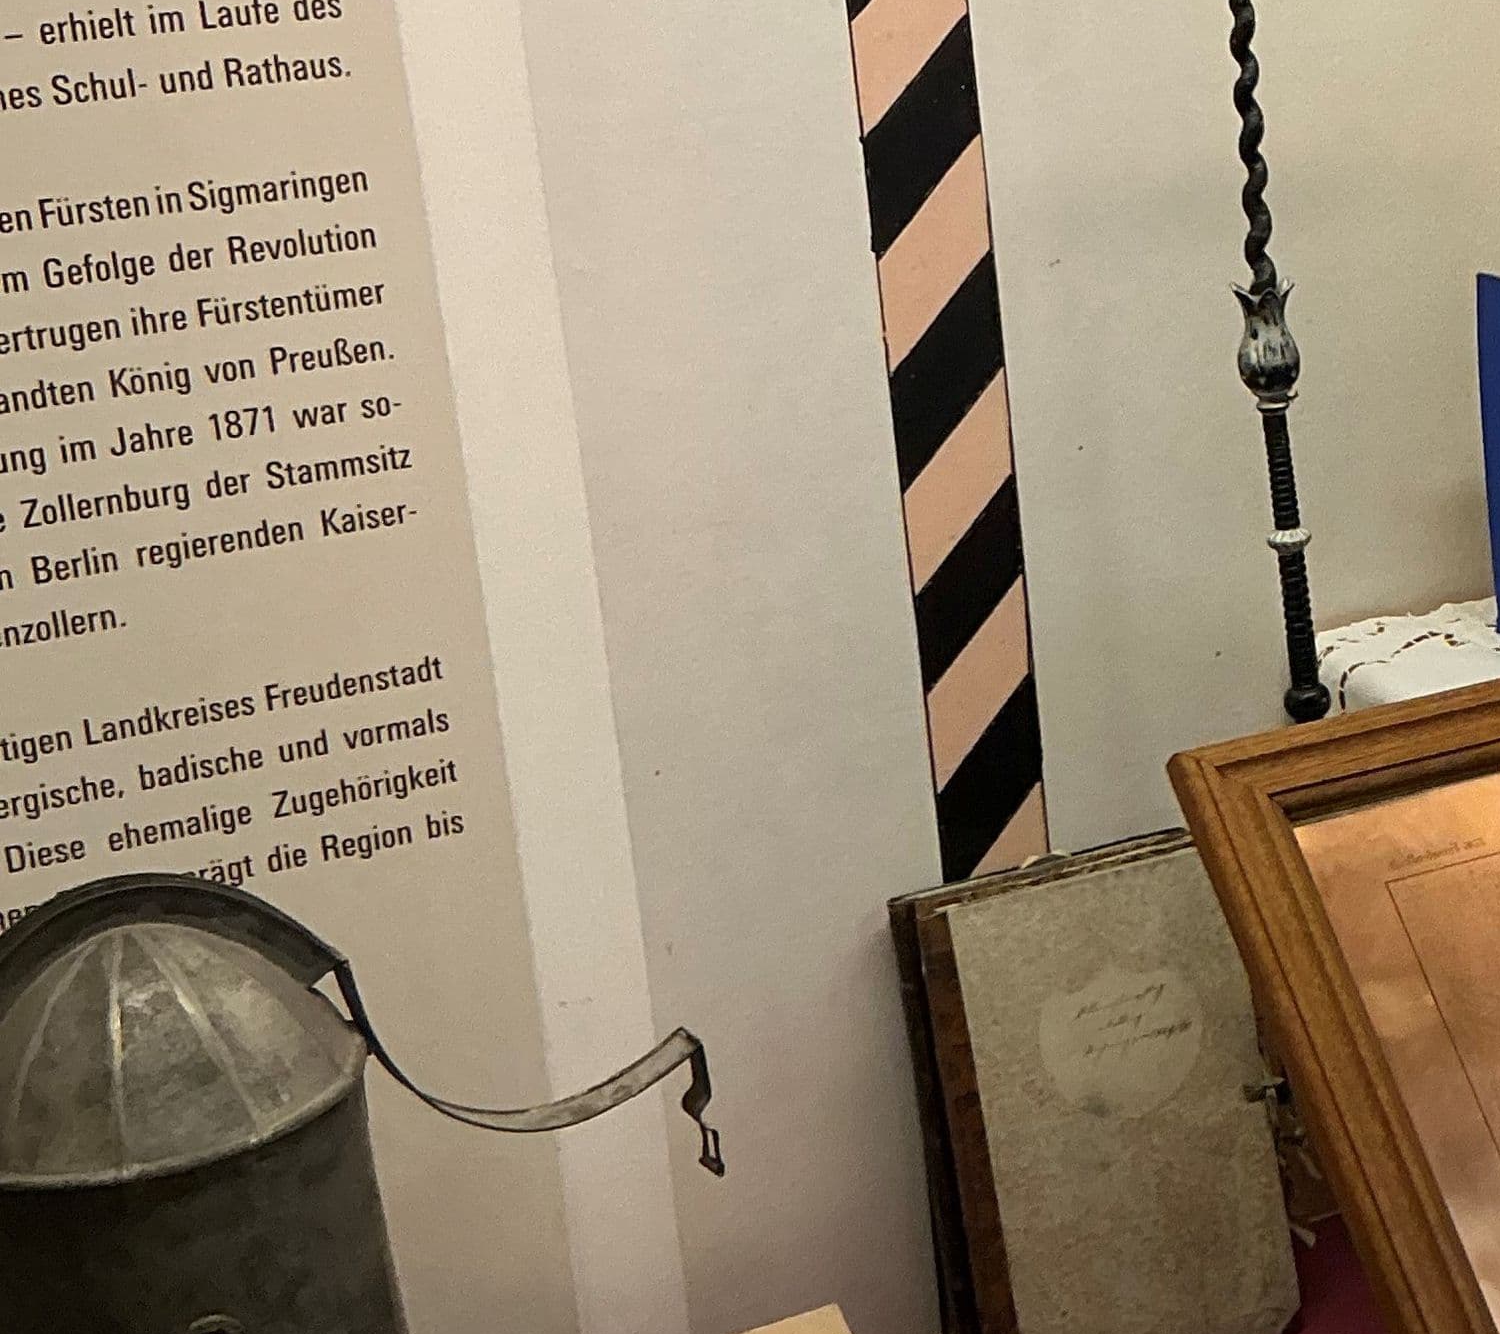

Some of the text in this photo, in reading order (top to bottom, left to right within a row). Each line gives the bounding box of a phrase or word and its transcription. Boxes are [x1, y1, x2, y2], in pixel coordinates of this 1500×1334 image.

[40, 8, 136, 44] erhielt
[147, 5, 184, 34] im
[52, 68, 147, 105] Schul-
[159, 60, 213, 94] und
[223, 54, 351, 87] Rathaus.
[38, 195, 150, 229] Fürsten
[155, 185, 182, 215] in
[187, 170, 369, 214] Sigmaringen
[43, 251, 155, 288] Gefolge
[169, 243, 214, 272] der
[227, 224, 376, 264] Revolution
[130, 306, 188, 336] ihre
[197, 284, 384, 327] Fürstentümer
[109, 362, 191, 397] König
[204, 359, 255, 383] von
[270, 338, 394, 375] Preußen.
[59, 436, 96, 463] im
[111, 423, 193, 456] Jahre
[209, 406, 274, 441] 1871
[293, 403, 347, 429] war
[361, 397, 401, 418] so-
[20, 484, 190, 528] Zollernburg
[206, 470, 250, 498] der
[266, 445, 412, 489] Stammsitz
[31, 547, 118, 584] Berlin
[136, 519, 304, 568] regierenden
[320, 504, 417, 536] Kaiser-
[0, 610, 126, 647] nzollern.
[83, 697, 255, 745] Landkreises
[264, 656, 443, 711] Freudenstadt
[138, 747, 263, 790] badische
[278, 729, 328, 762] und
[343, 708, 449, 749] vormals
[4, 759, 457, 873] Diese ehemalige Zugehörigkeit
[180, 811, 464, 888] rägt die Region bis
